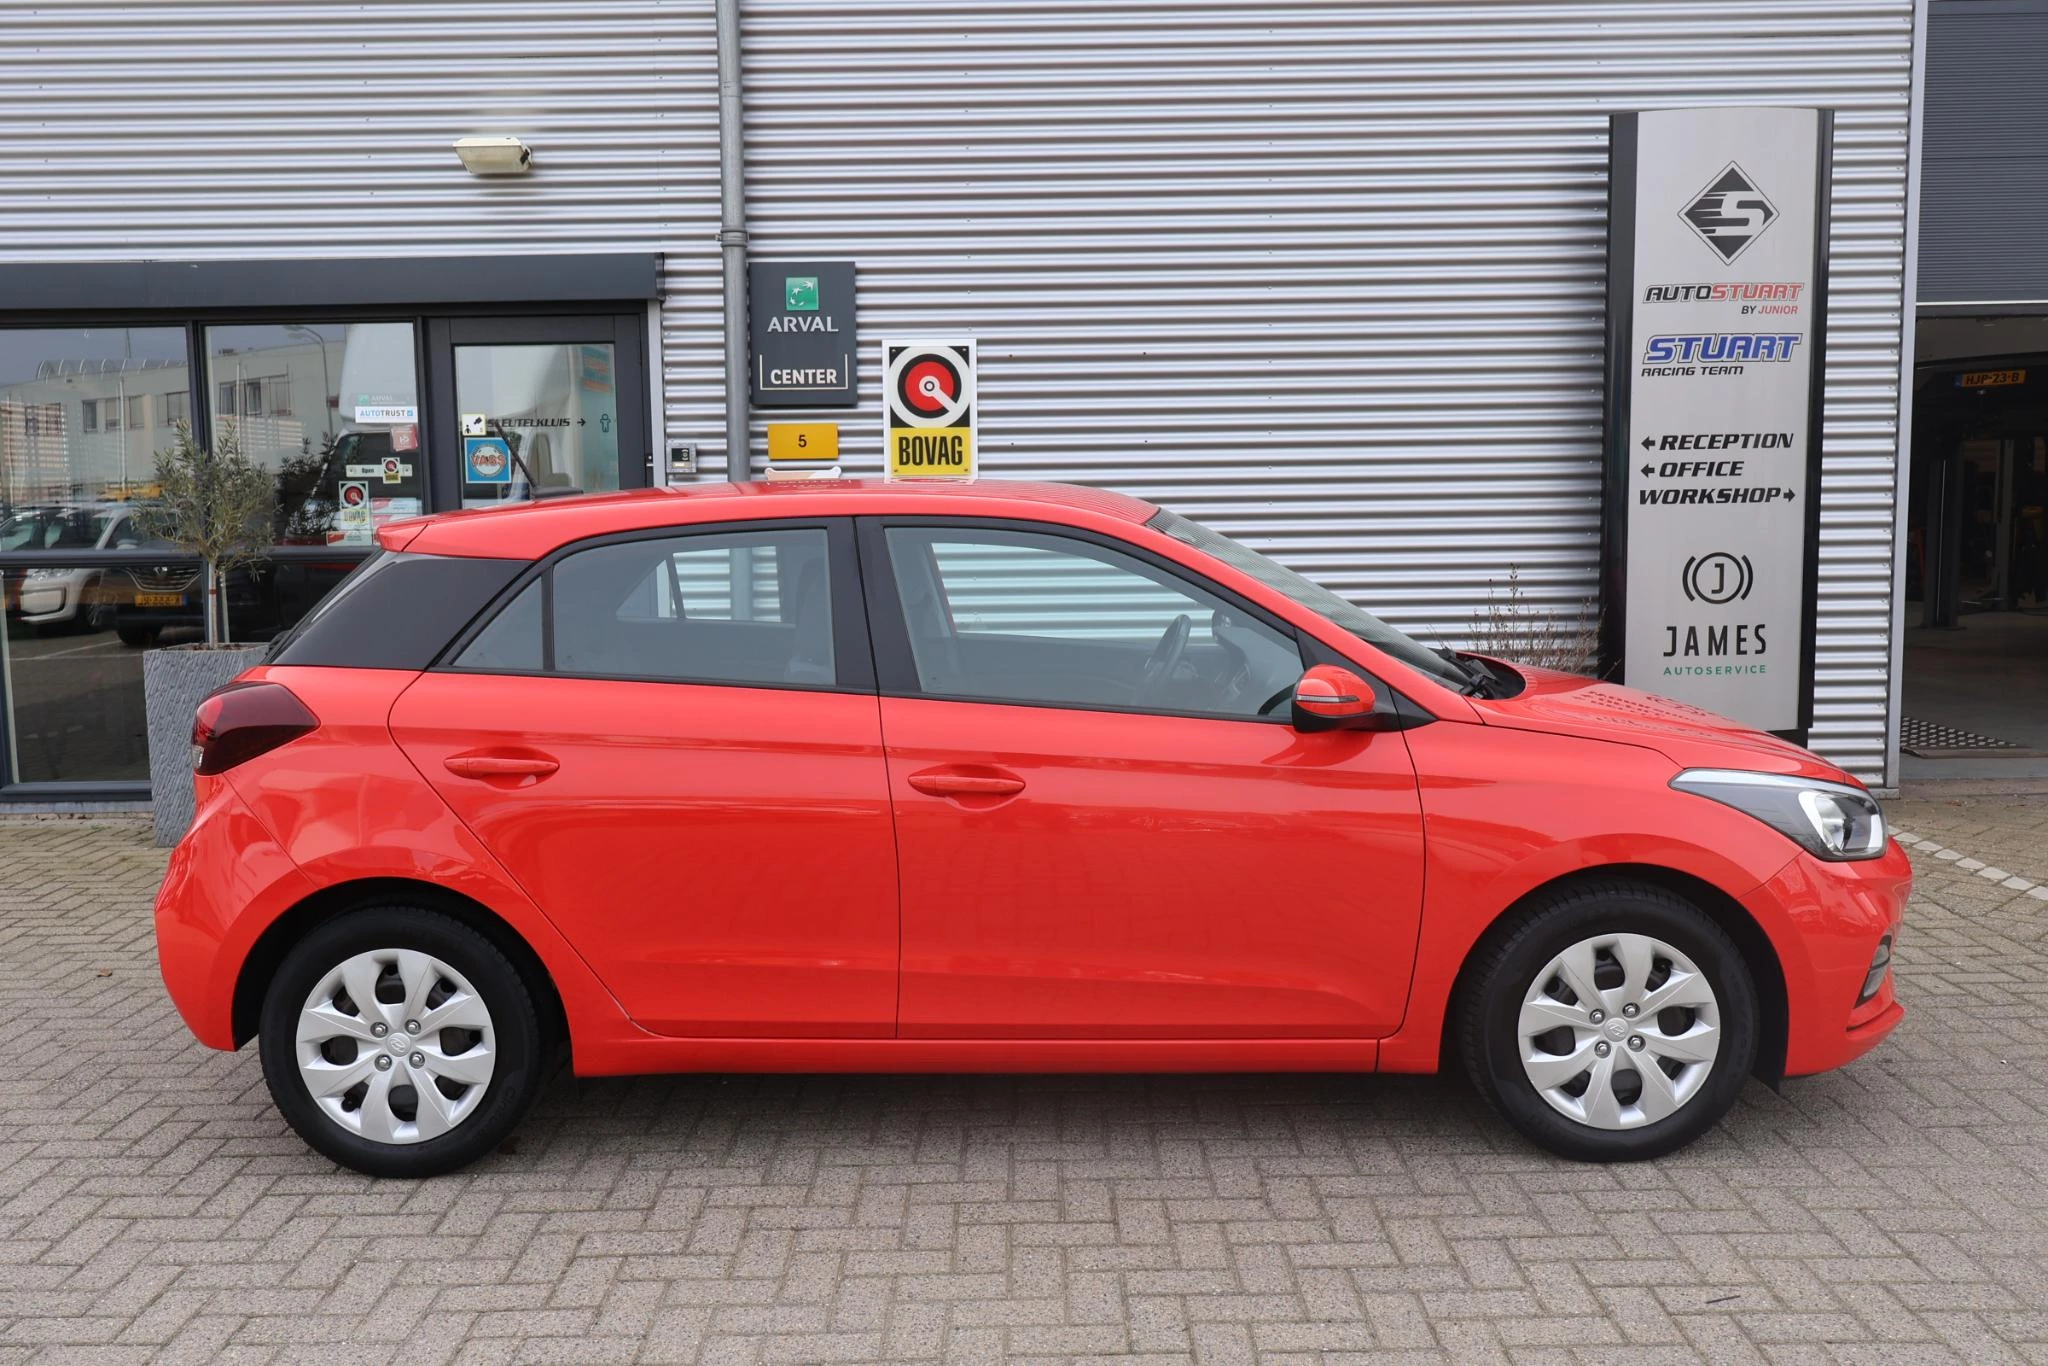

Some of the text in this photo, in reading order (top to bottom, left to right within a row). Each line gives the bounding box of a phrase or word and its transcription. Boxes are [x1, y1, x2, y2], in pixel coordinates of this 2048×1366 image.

[1643, 282, 1803, 303] AUTOSTUART
[1741, 305, 1799, 315] BY JUNIOR
[767, 316, 839, 333] ARVAL
[1643, 333, 1802, 363] STUART
[770, 369, 837, 385] CENTER
[1641, 366, 1744, 377] RACING TEAM
[360, 409, 406, 417] AUTOTRUST
[798, 435, 807, 448] 5
[1659, 433, 1794, 450] RECEPTION
[898, 435, 963, 466] BOVAG
[1659, 461, 1745, 477] OFFICE
[1639, 487, 1781, 505] WORKSHOP
[1663, 624, 1767, 657] JAMES
[1663, 664, 1767, 676] AUTOSERVICE
